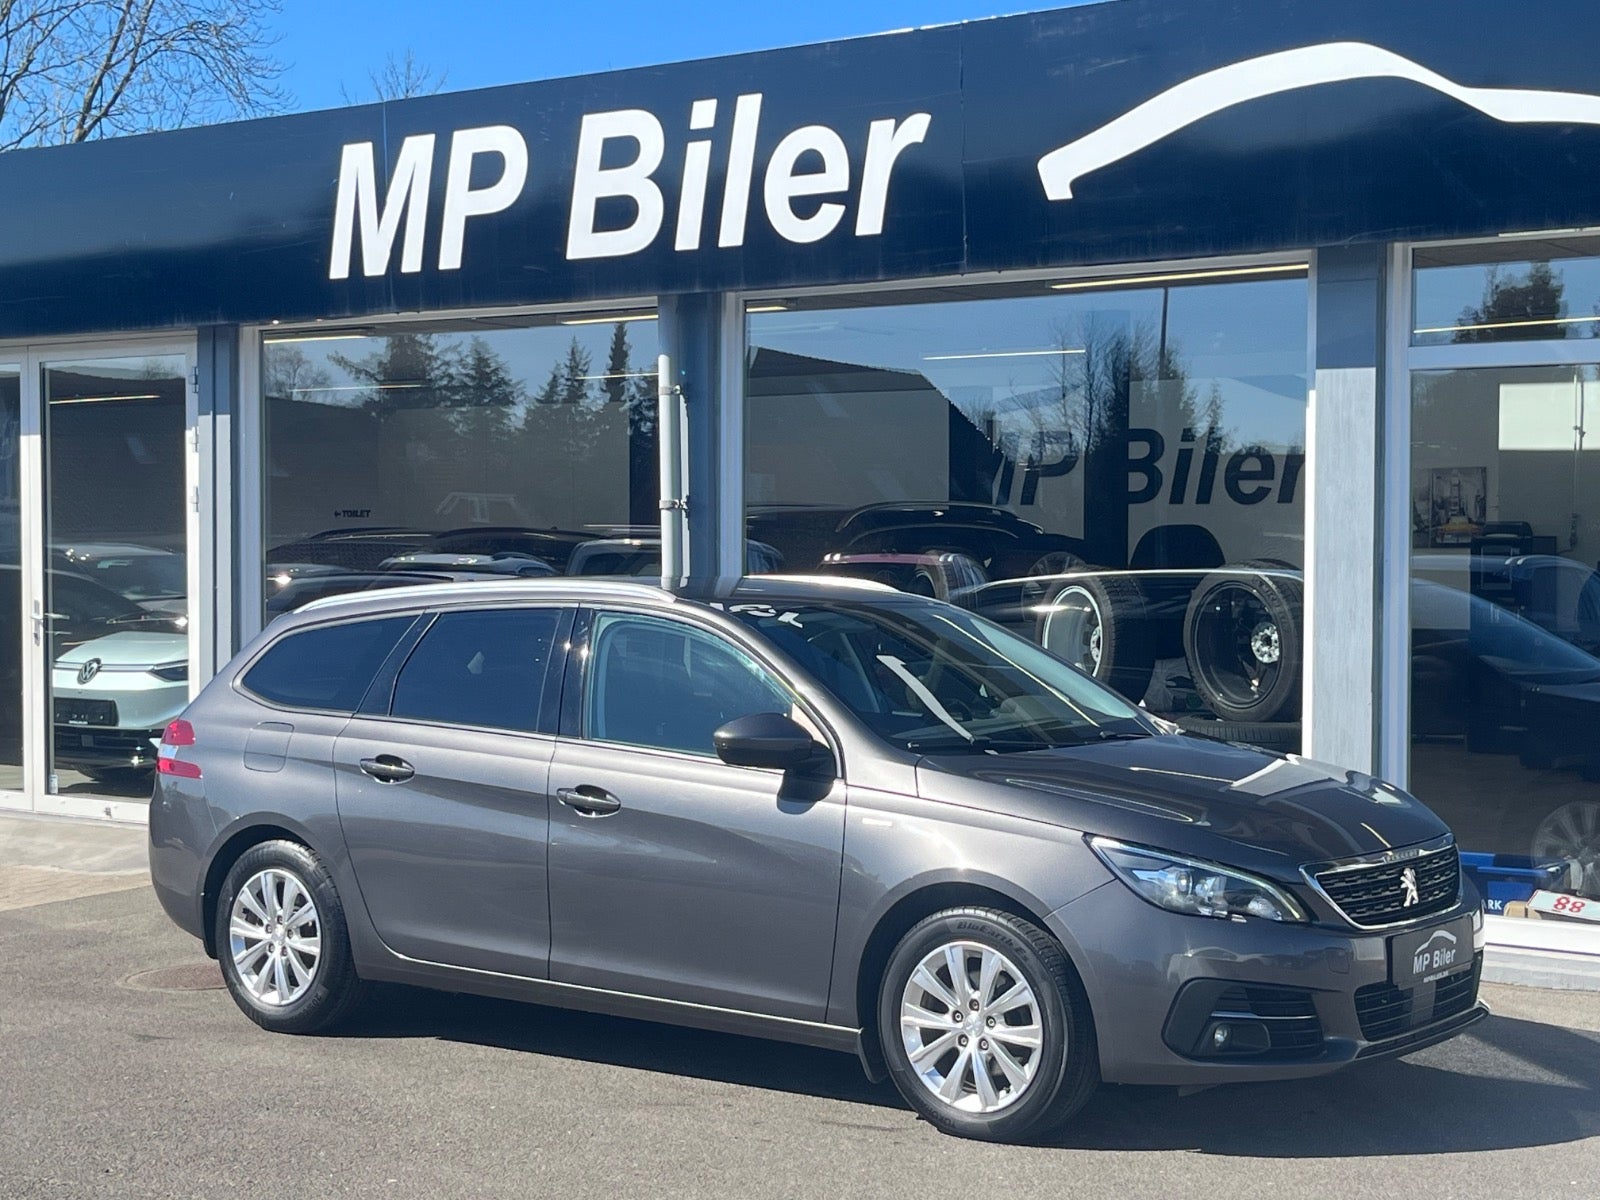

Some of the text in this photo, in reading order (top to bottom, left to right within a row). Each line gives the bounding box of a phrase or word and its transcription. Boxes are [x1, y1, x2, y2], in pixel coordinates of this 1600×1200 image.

[329, 92, 932, 280] MP Biler
[1122, 427, 1304, 505] Biler
[342, 509, 371, 518] TOILET
[1553, 896, 1586, 913] 88
[1412, 947, 1456, 975] MP Biler
